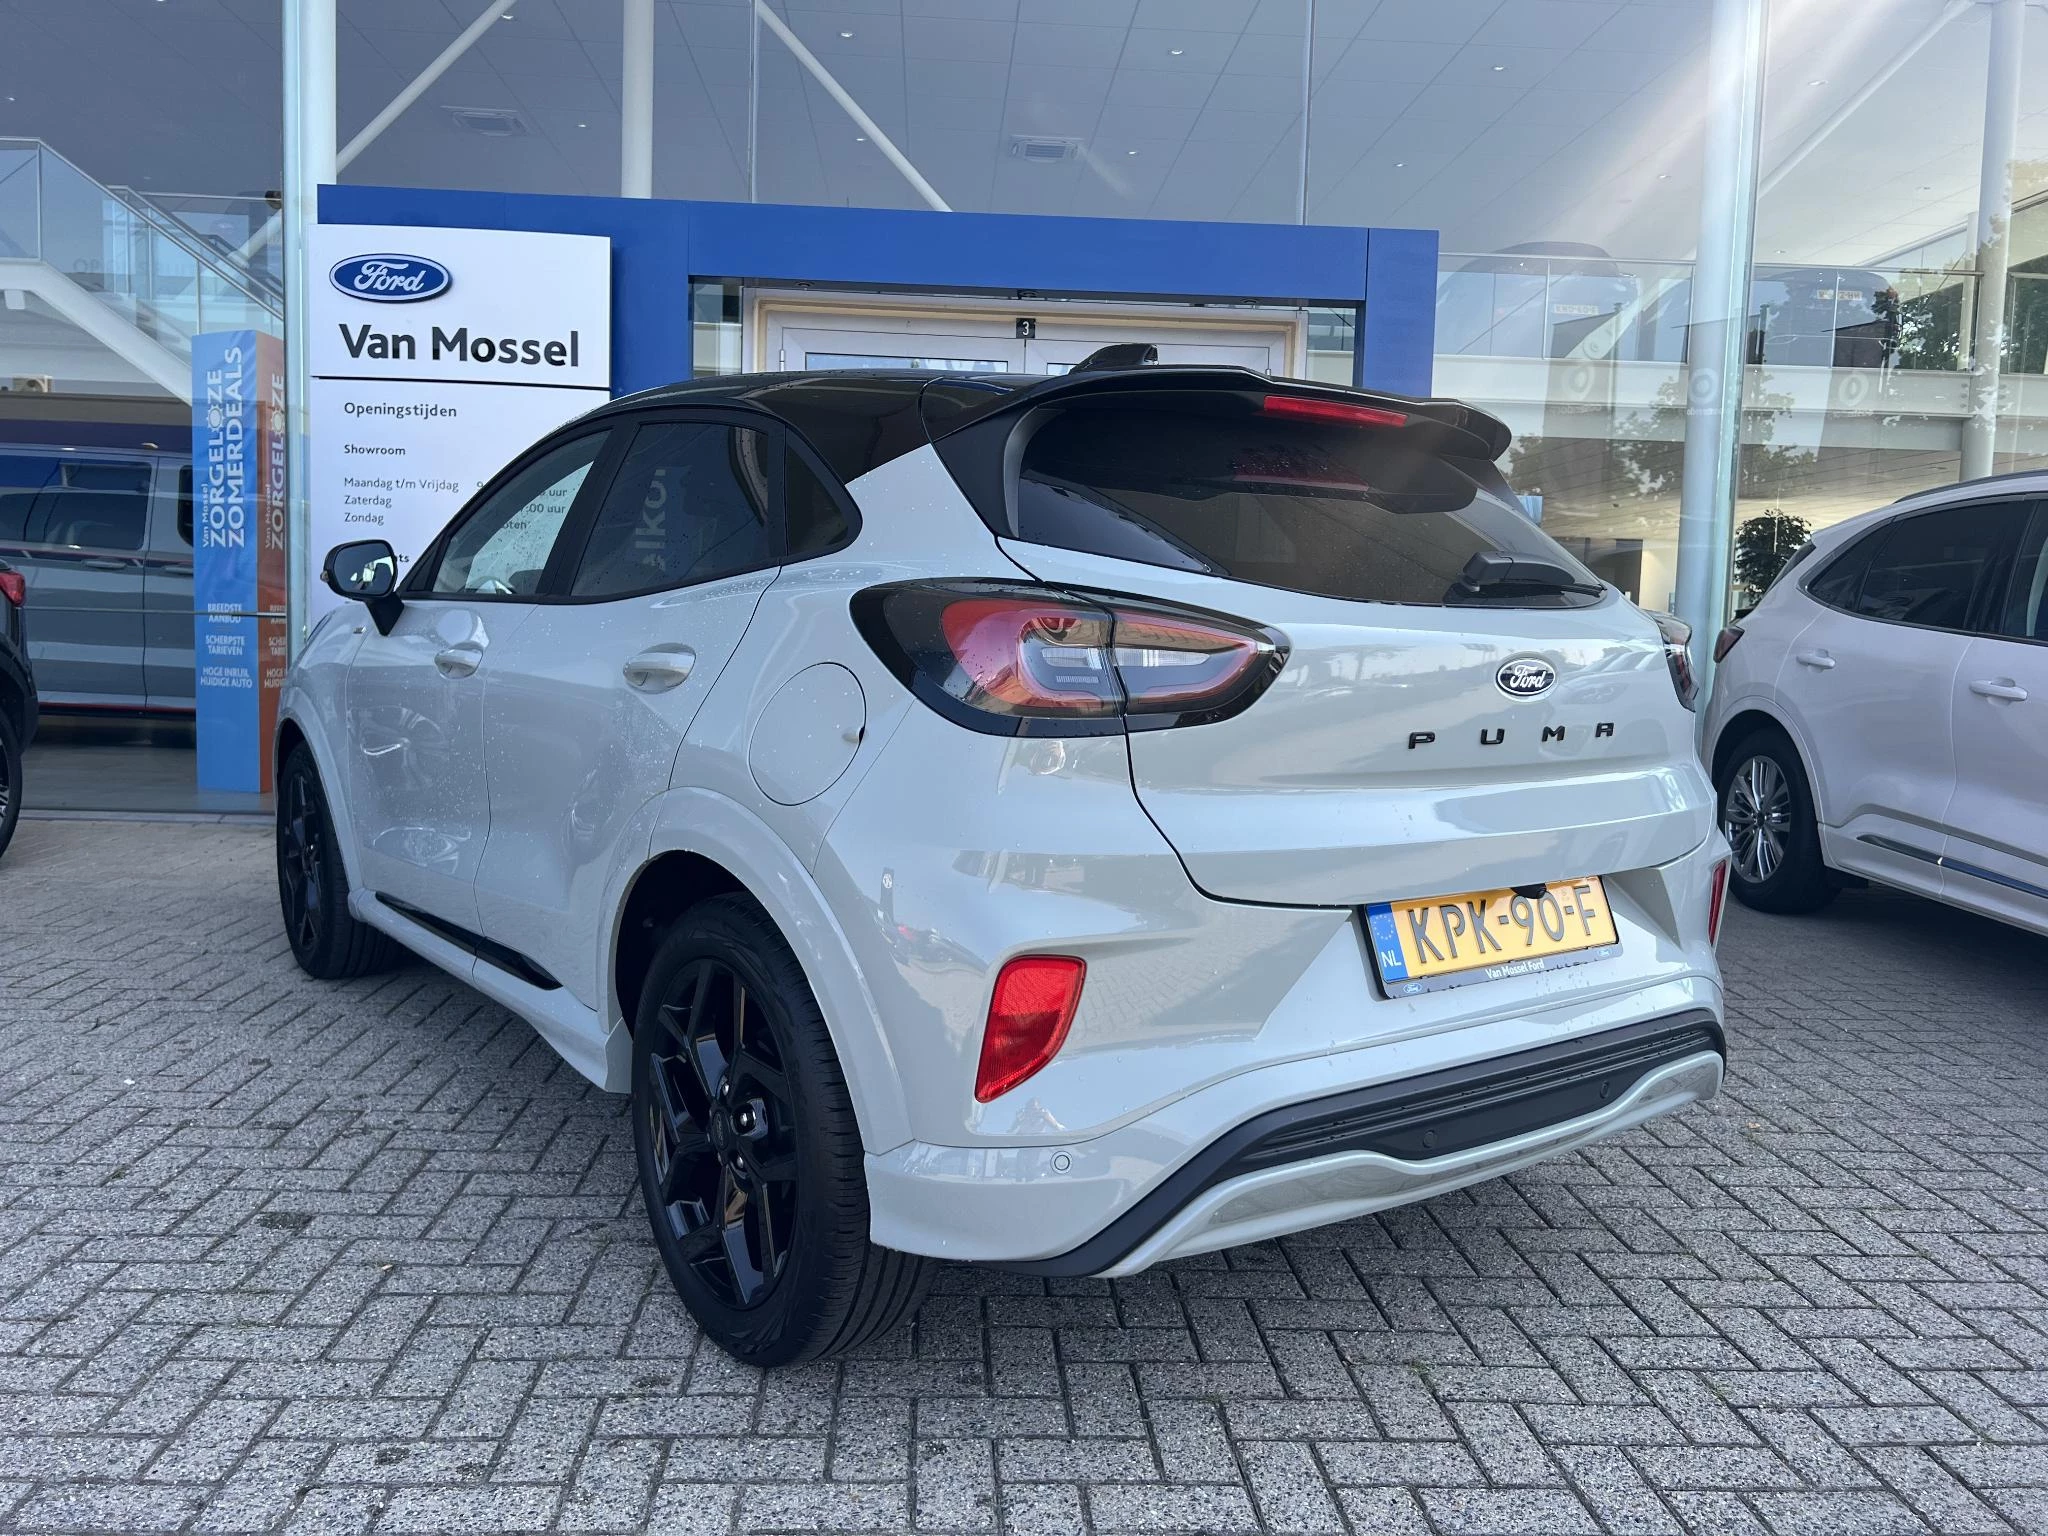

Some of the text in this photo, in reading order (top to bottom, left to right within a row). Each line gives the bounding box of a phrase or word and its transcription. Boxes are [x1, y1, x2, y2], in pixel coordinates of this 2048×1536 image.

[353, 260, 427, 292] Ford
[1022, 321, 1030, 336] 3
[338, 323, 579, 367] Van Mossel
[344, 402, 457, 420] Openingstijden
[224, 346, 245, 548] ZOMERDEALS
[344, 444, 406, 456] Showroom
[344, 477, 459, 494] Maandag t/m Vrijdag
[548, 488, 568, 497] uur
[344, 494, 392, 509] Zaterdag
[547, 505, 566, 514] uur
[200, 483, 210, 548] Van Mossel
[344, 512, 384, 526] Zondag
[207, 603, 242, 613] BREEDSTE
[205, 634, 246, 646] SCHERPSTE
[208, 645, 243, 656] TARIEVEN
[202, 665, 222, 677] HOGE
[1509, 664, 1547, 689] Ford
[231, 678, 253, 689] AUTO
[1407, 721, 1616, 750] PUMA
[1406, 884, 1597, 965] KPK-90-F
[1380, 950, 1402, 969] NL
[1485, 957, 1545, 979] Van Mossel Ford
